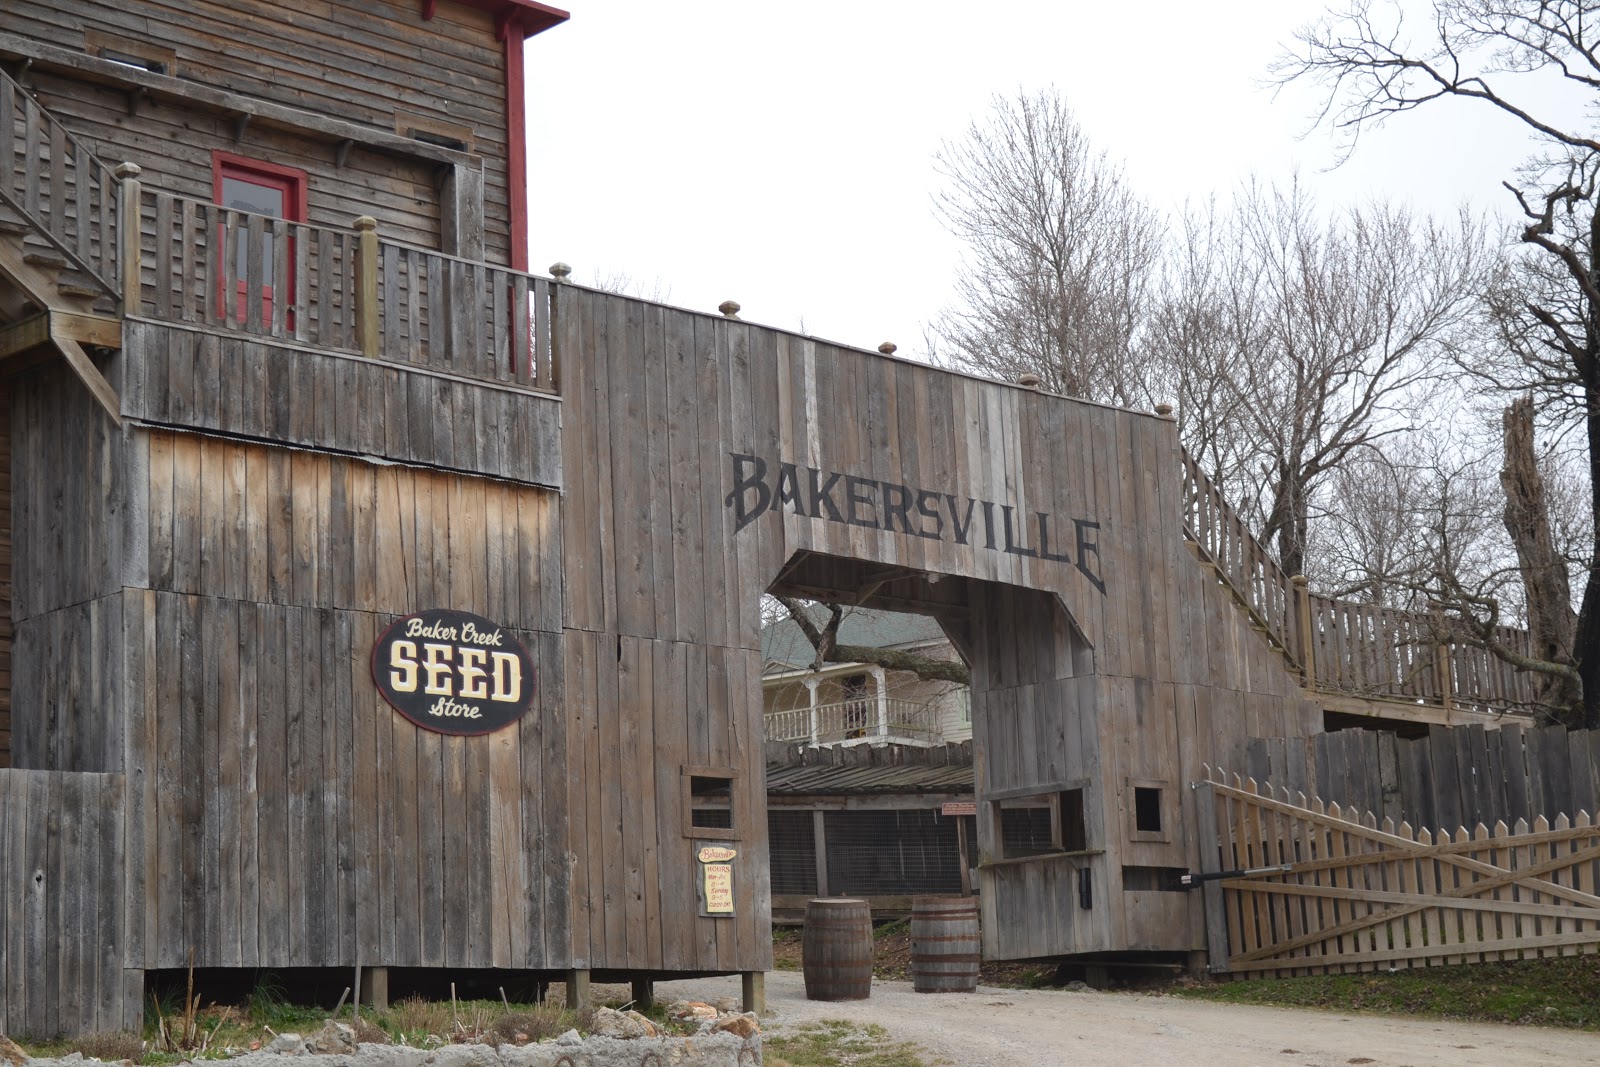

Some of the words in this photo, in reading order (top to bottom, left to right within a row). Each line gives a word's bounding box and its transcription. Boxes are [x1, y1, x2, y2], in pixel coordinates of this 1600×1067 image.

[725, 452, 1107, 598] BAKERSVILLE
[405, 618, 457, 641] Baker
[461, 622, 503, 646] Creek
[390, 640, 522, 703] SEED
[428, 697, 483, 719] Store
